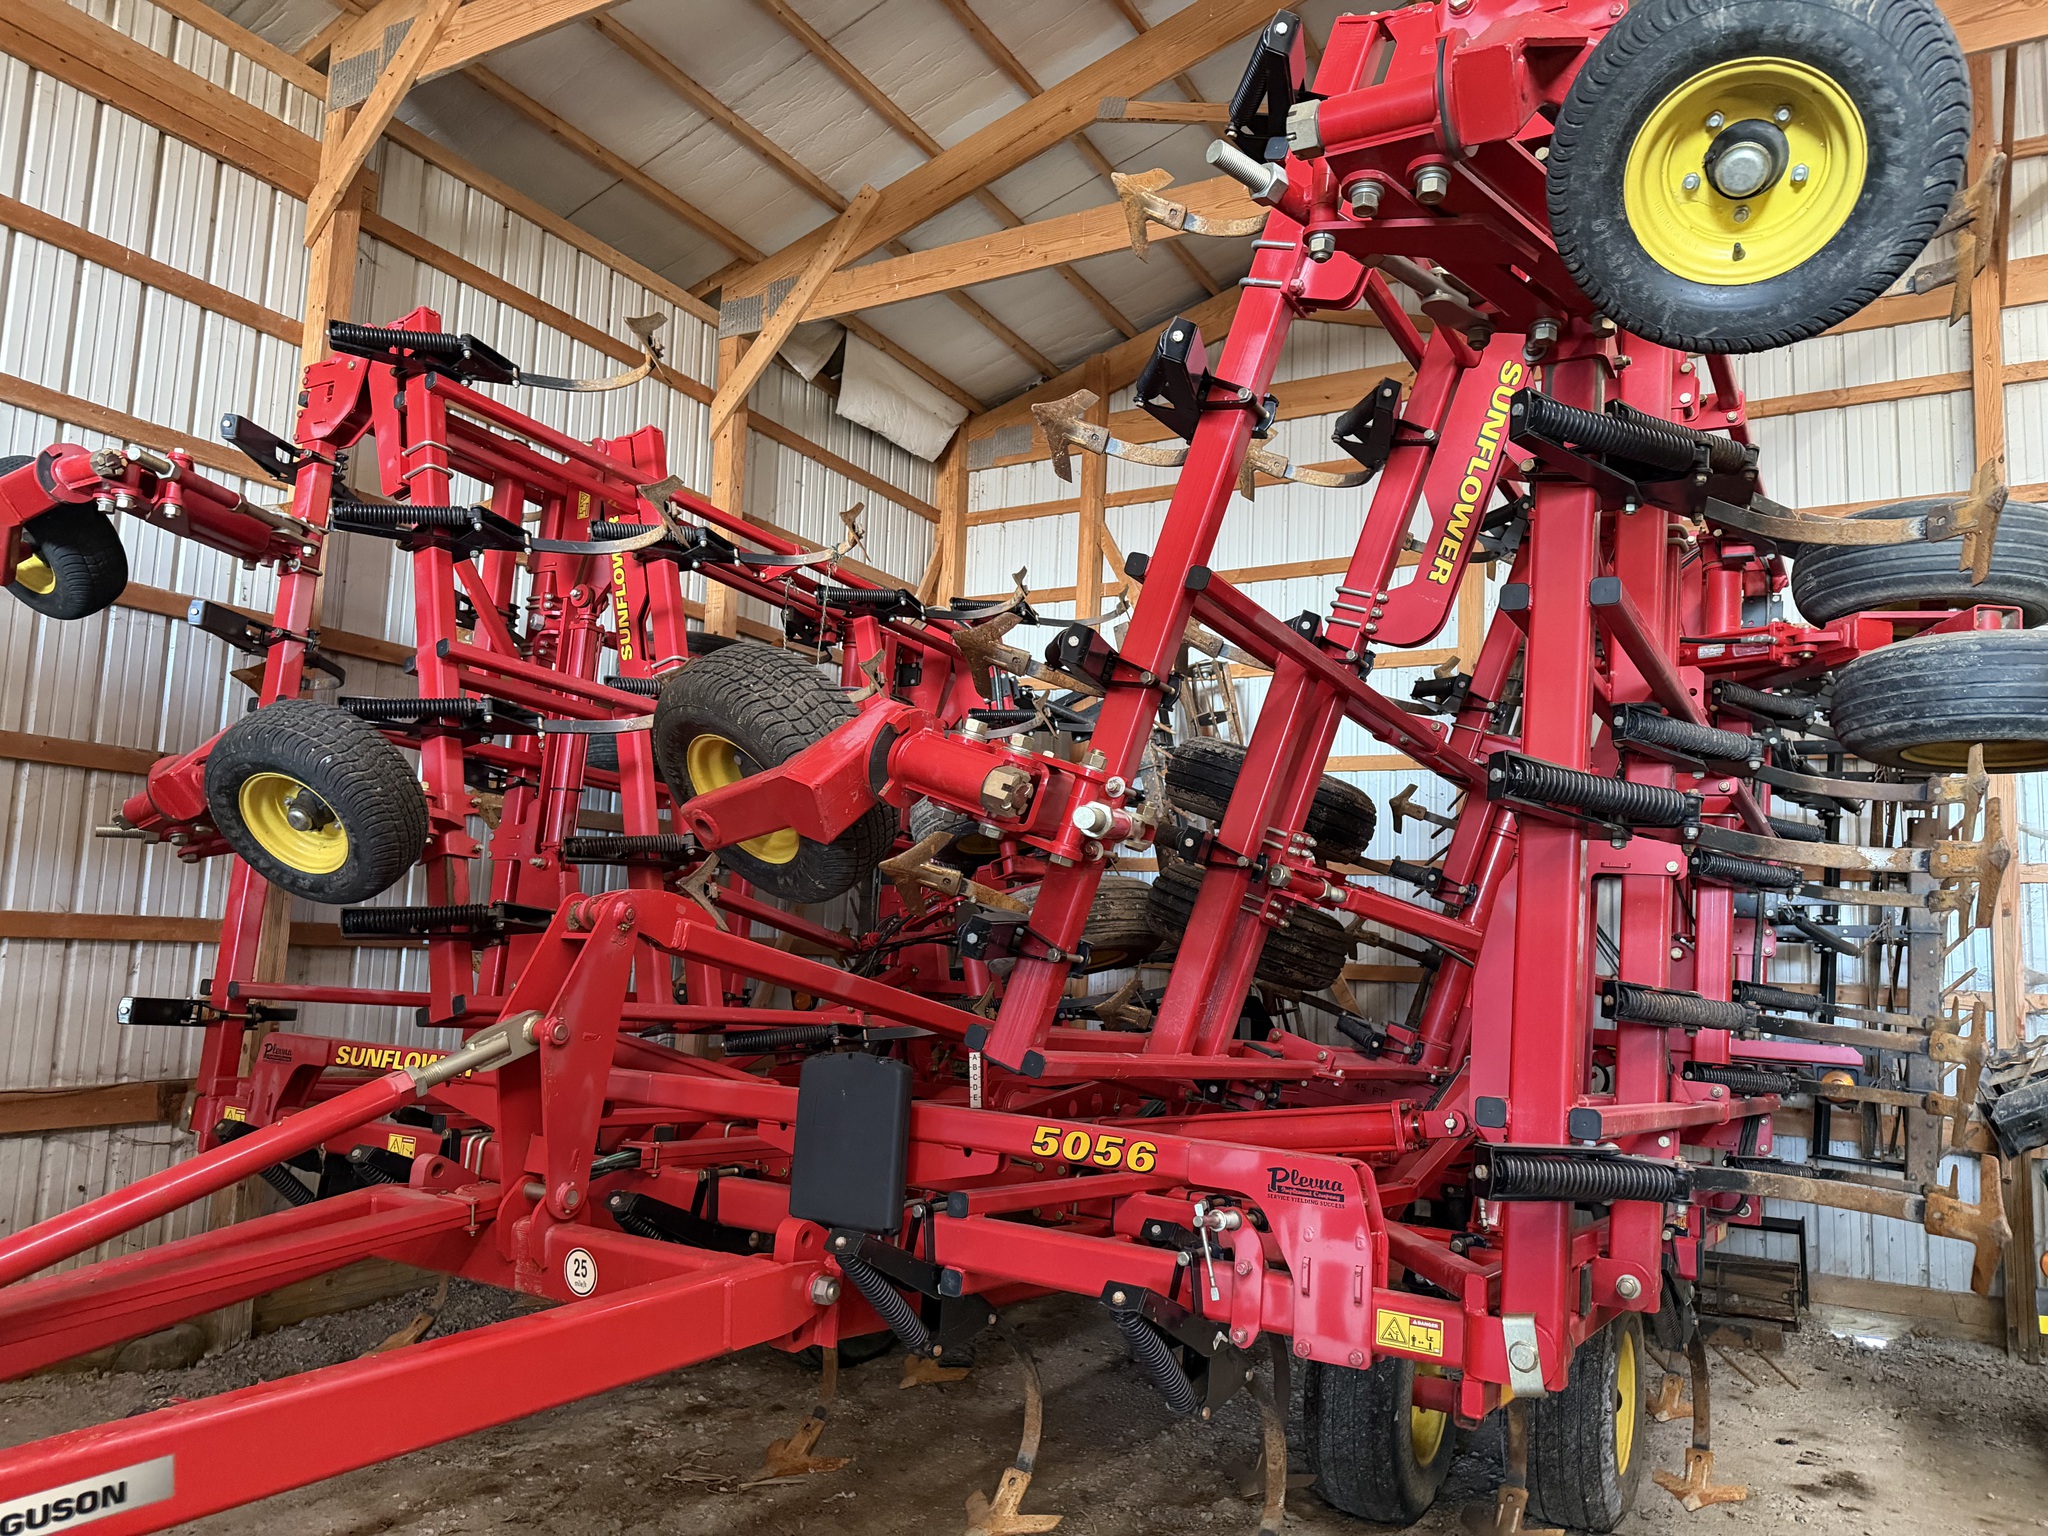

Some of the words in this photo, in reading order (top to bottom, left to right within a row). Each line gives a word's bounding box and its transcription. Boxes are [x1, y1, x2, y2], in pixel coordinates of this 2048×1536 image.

[1427, 360, 1523, 585] SUNFLOWER
[1030, 1125, 1158, 1174] 5056
[1267, 1167, 1344, 1192] Plevna
[1267, 1194, 1290, 1202] SERVICE
[1291, 1197, 1319, 1206] YIELDING
[1319, 1201, 1345, 1209] SUCCESS
[573, 1258, 588, 1278] 25
[1417, 1320, 1439, 1328] DANGER
